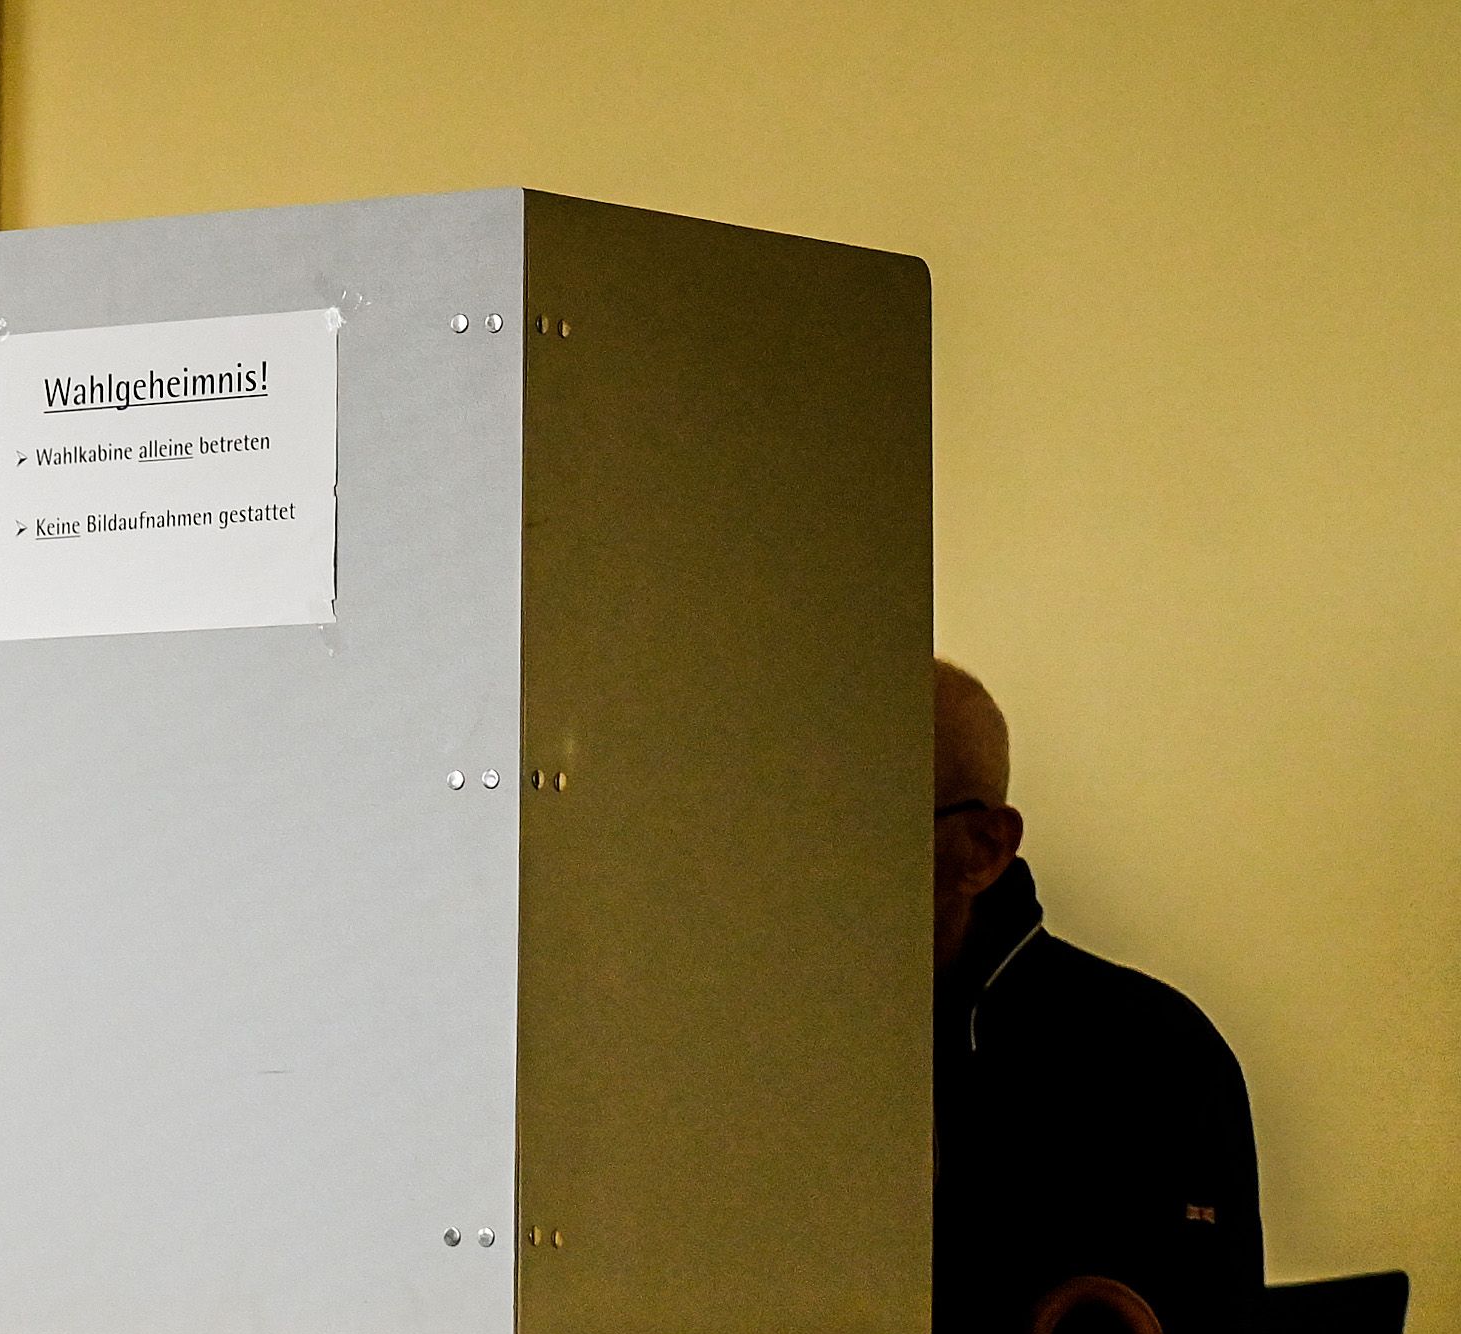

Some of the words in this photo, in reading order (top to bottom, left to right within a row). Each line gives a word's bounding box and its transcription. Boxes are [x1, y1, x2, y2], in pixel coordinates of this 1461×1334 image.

[44, 361, 268, 413] Wahlgeheimnis!
[36, 443, 133, 467] Wahlkabine
[138, 439, 193, 462] alleine
[200, 434, 270, 455] betreten
[35, 518, 81, 540] Keine
[86, 510, 212, 534] Bildaufnahmen
[218, 502, 296, 529] gestattet
